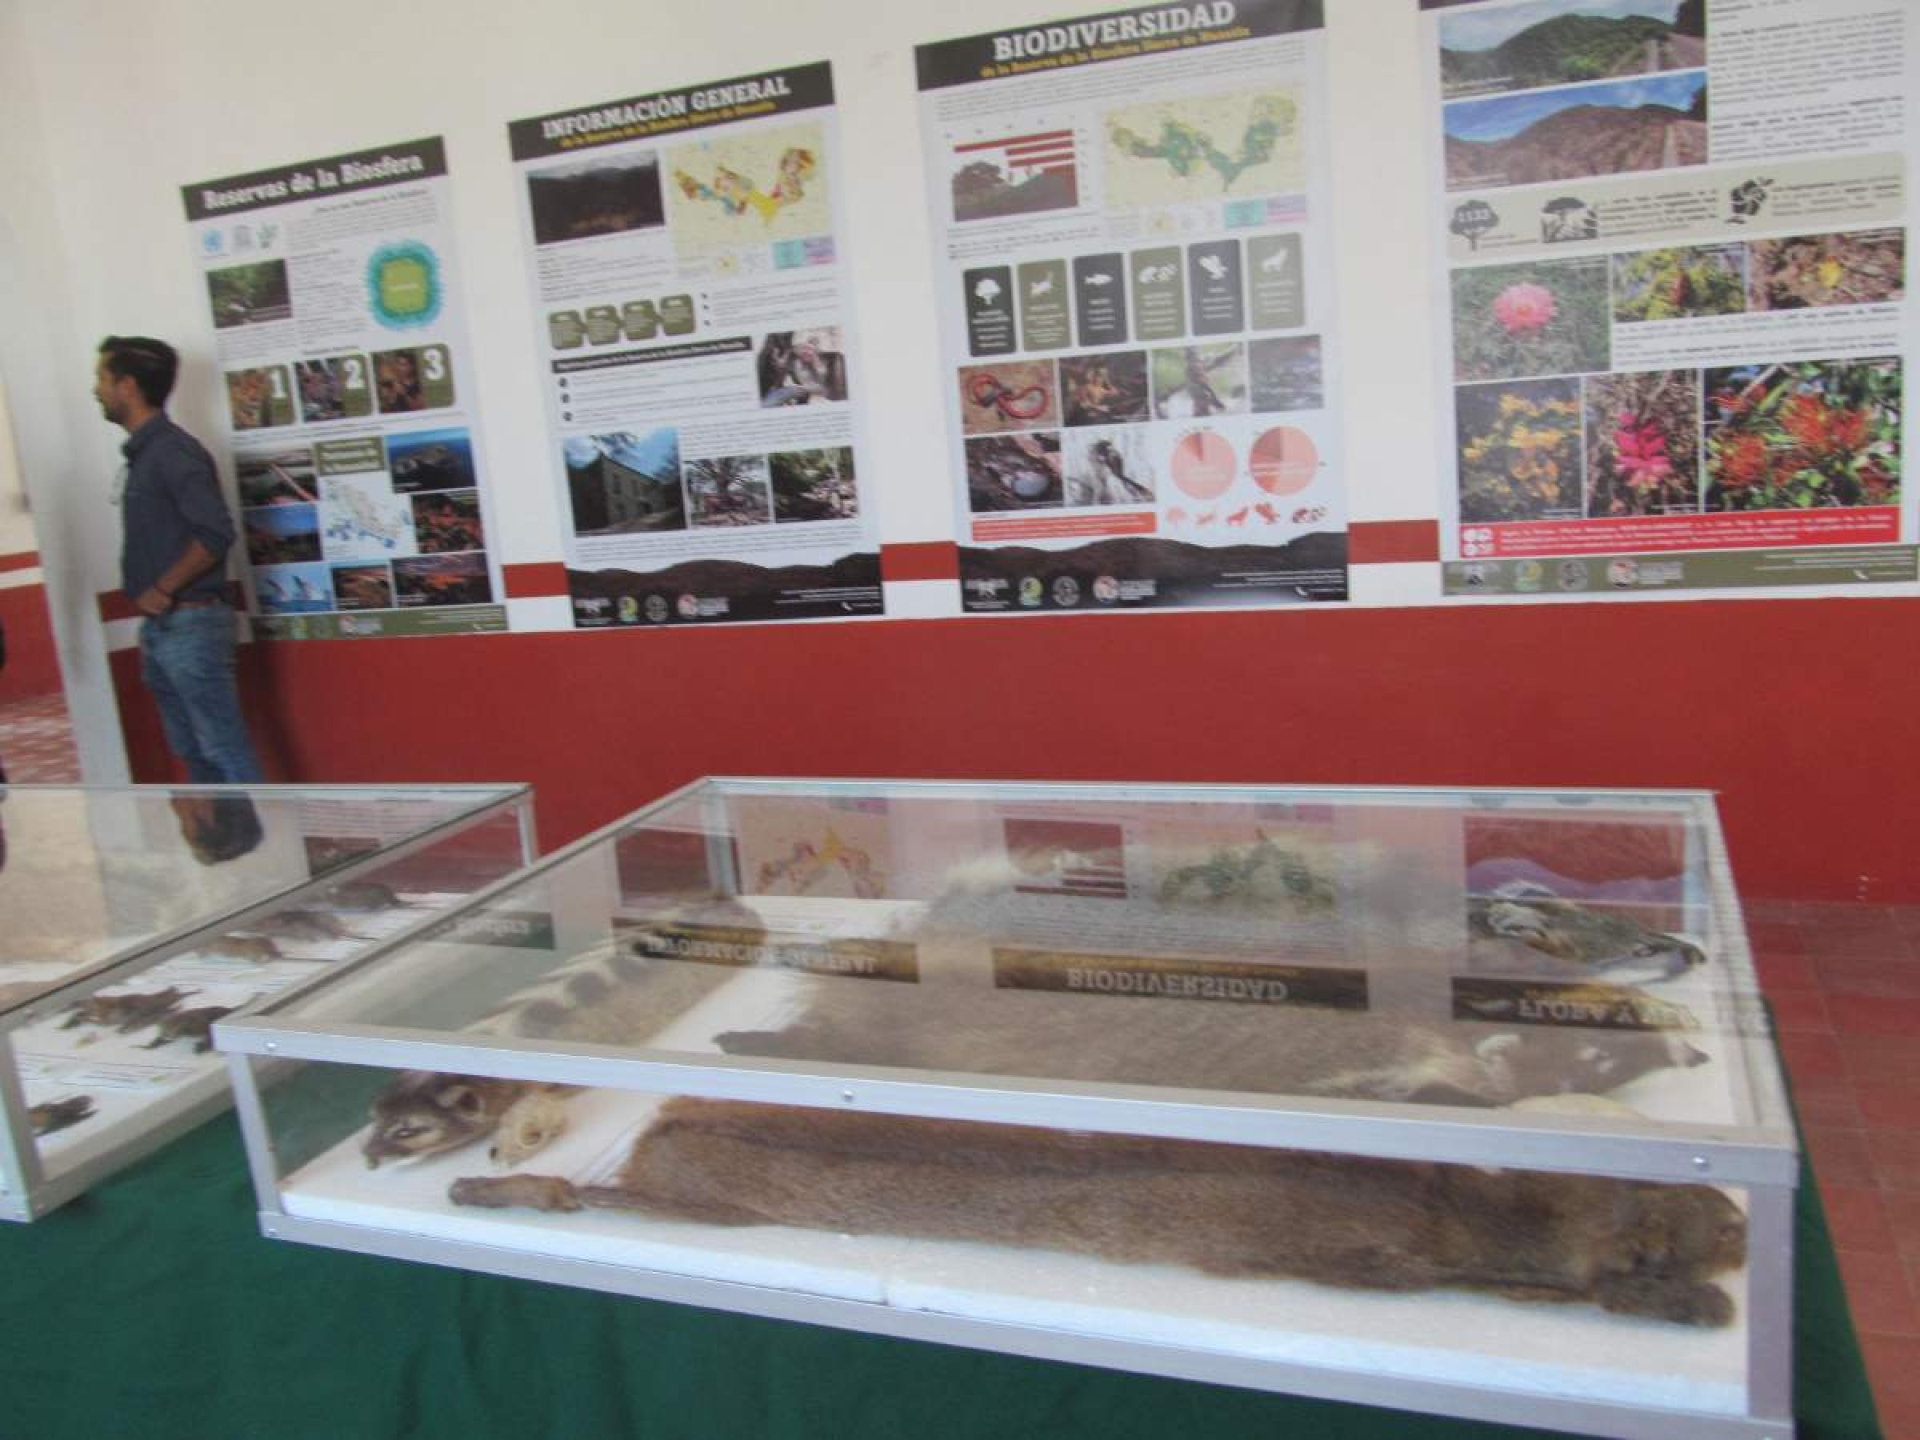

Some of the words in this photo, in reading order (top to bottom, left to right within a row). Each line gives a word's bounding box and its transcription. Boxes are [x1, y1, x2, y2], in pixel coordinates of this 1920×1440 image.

[992, 2, 1237, 61] BIODIVERSIDAD
[542, 95, 688, 138] INFORMACIÓN
[690, 76, 792, 110] GENERAL
[201, 180, 288, 210] Reservas
[290, 171, 315, 193] de
[316, 167, 338, 188] la
[343, 359, 365, 390] 2
[423, 348, 445, 381] 3
[270, 369, 286, 399] 1
